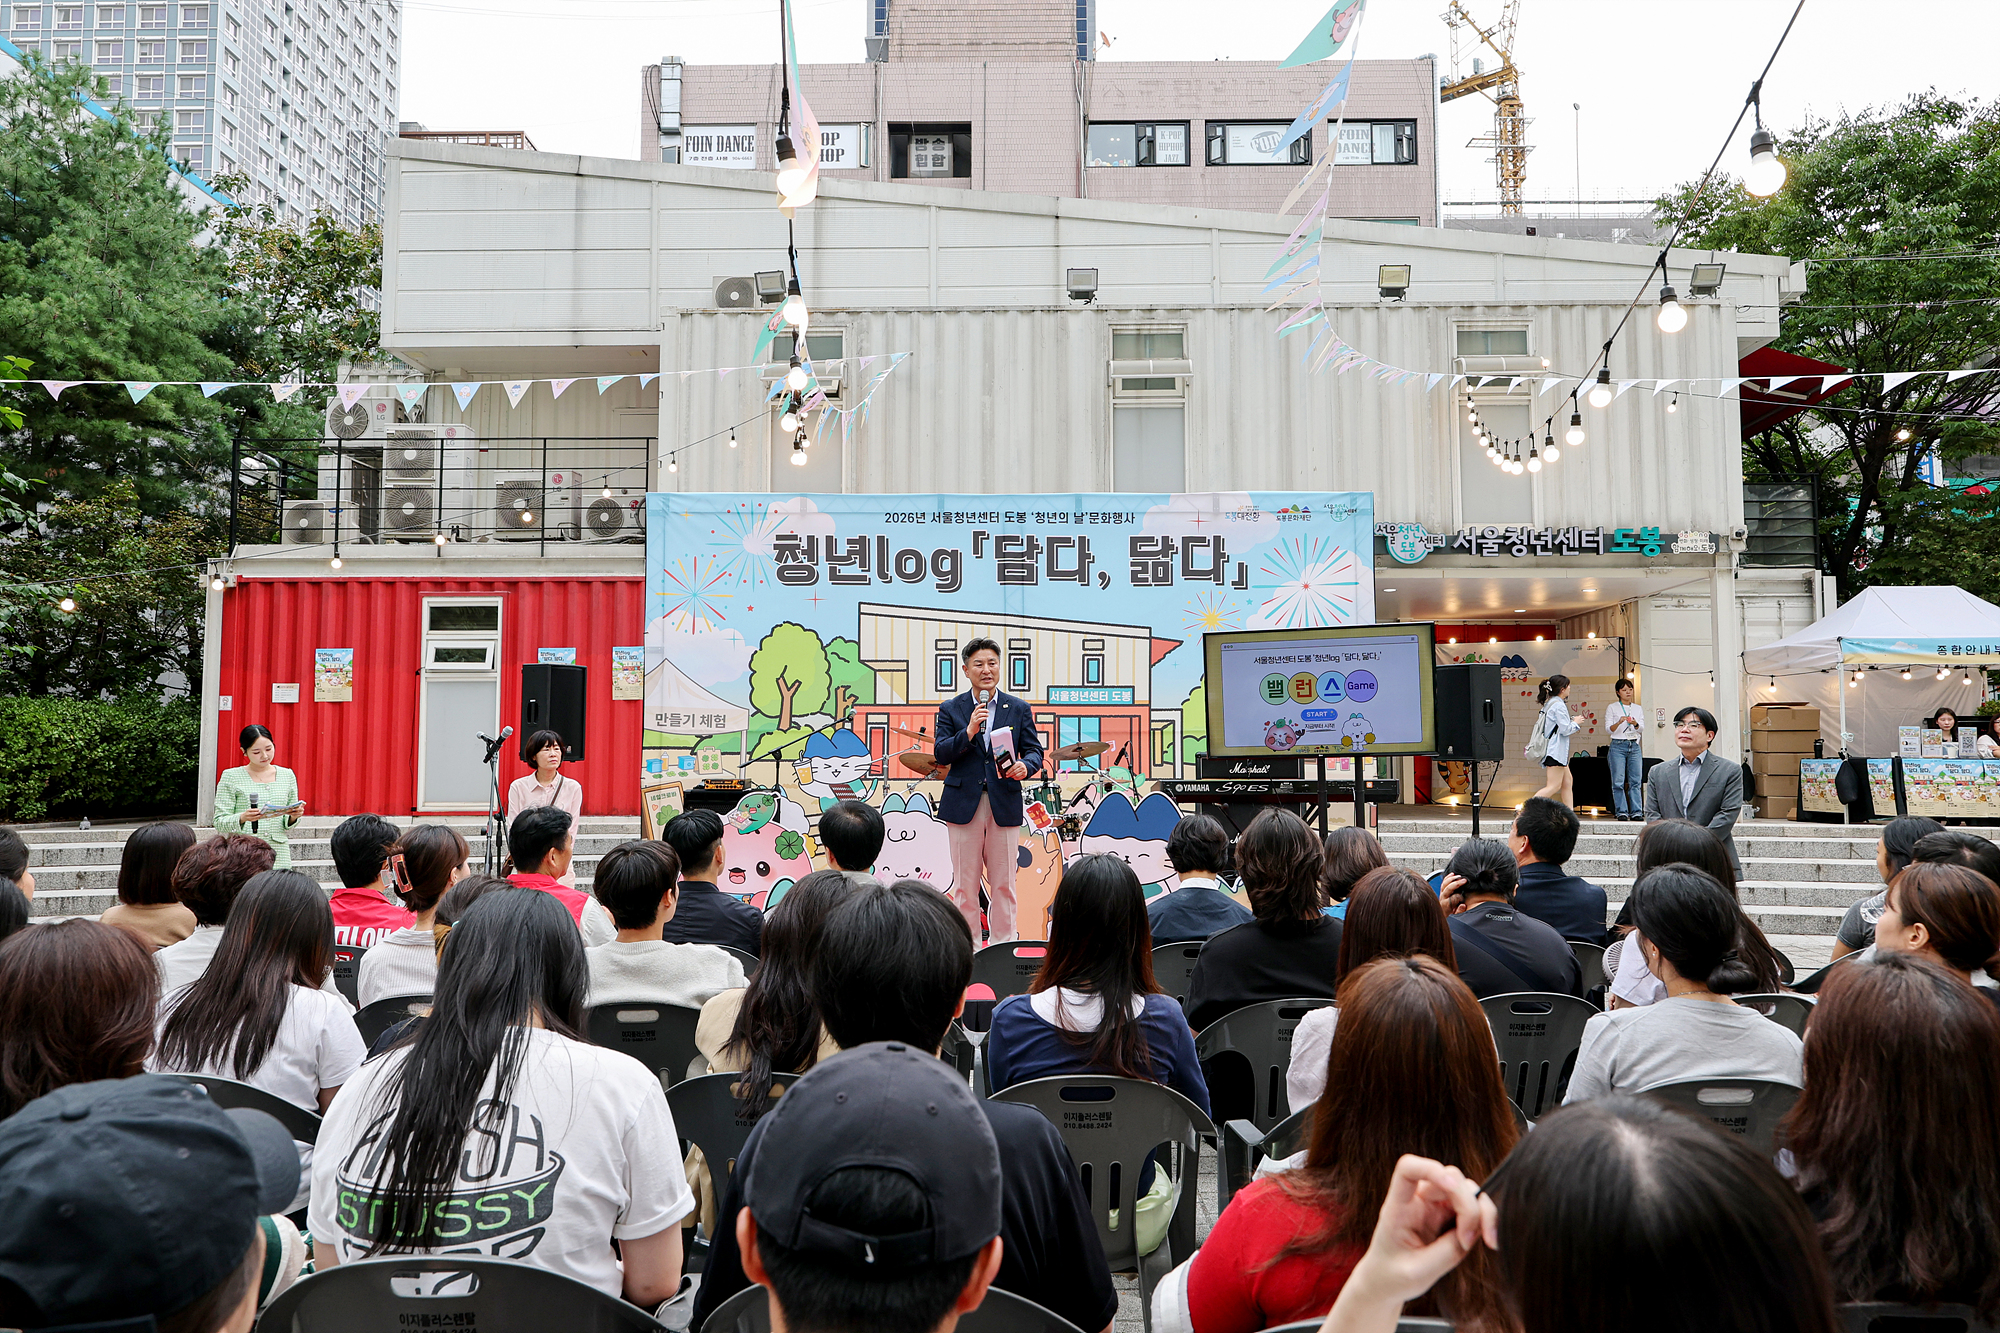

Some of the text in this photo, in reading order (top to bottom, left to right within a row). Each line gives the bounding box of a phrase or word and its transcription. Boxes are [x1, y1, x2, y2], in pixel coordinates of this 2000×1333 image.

[820, 131, 840, 146] OP
[1160, 130, 1182, 140] K-POP
[1338, 128, 1370, 140] FOIN
[685, 135, 754, 152] FOIN DANCE
[915, 138, 945, 151] 방송
[1158, 142, 1184, 152] HIPHOP
[915, 154, 946, 167] 힙합
[1163, 153, 1180, 163] JAZZ
[884, 511, 927, 524] 2026년
[930, 511, 1000, 524] 서울청년센터
[1004, 511, 1027, 524] 도봉
[1452, 526, 1665, 557] 서울청년센터 도봉
[772, 534, 963, 593] 청년log
[1253, 655, 1296, 664] 서울청년센터
[1297, 654, 1312, 663] 도봉
[1347, 681, 1375, 690] Game
[1050, 690, 1132, 702] 서울청년센터 도봉
[655, 713, 727, 729] 만들기 체험
[1183, 784, 1210, 792] YAMAHA
[1247, 784, 1270, 792] ES
[1509, 1023, 1547, 1031] 이지플러스렌탈
[1063, 1111, 1113, 1121] 이지플러스렌탈
[338, 1182, 550, 1239] STUSSY
[399, 1312, 476, 1327] 이지플러스렌탈
